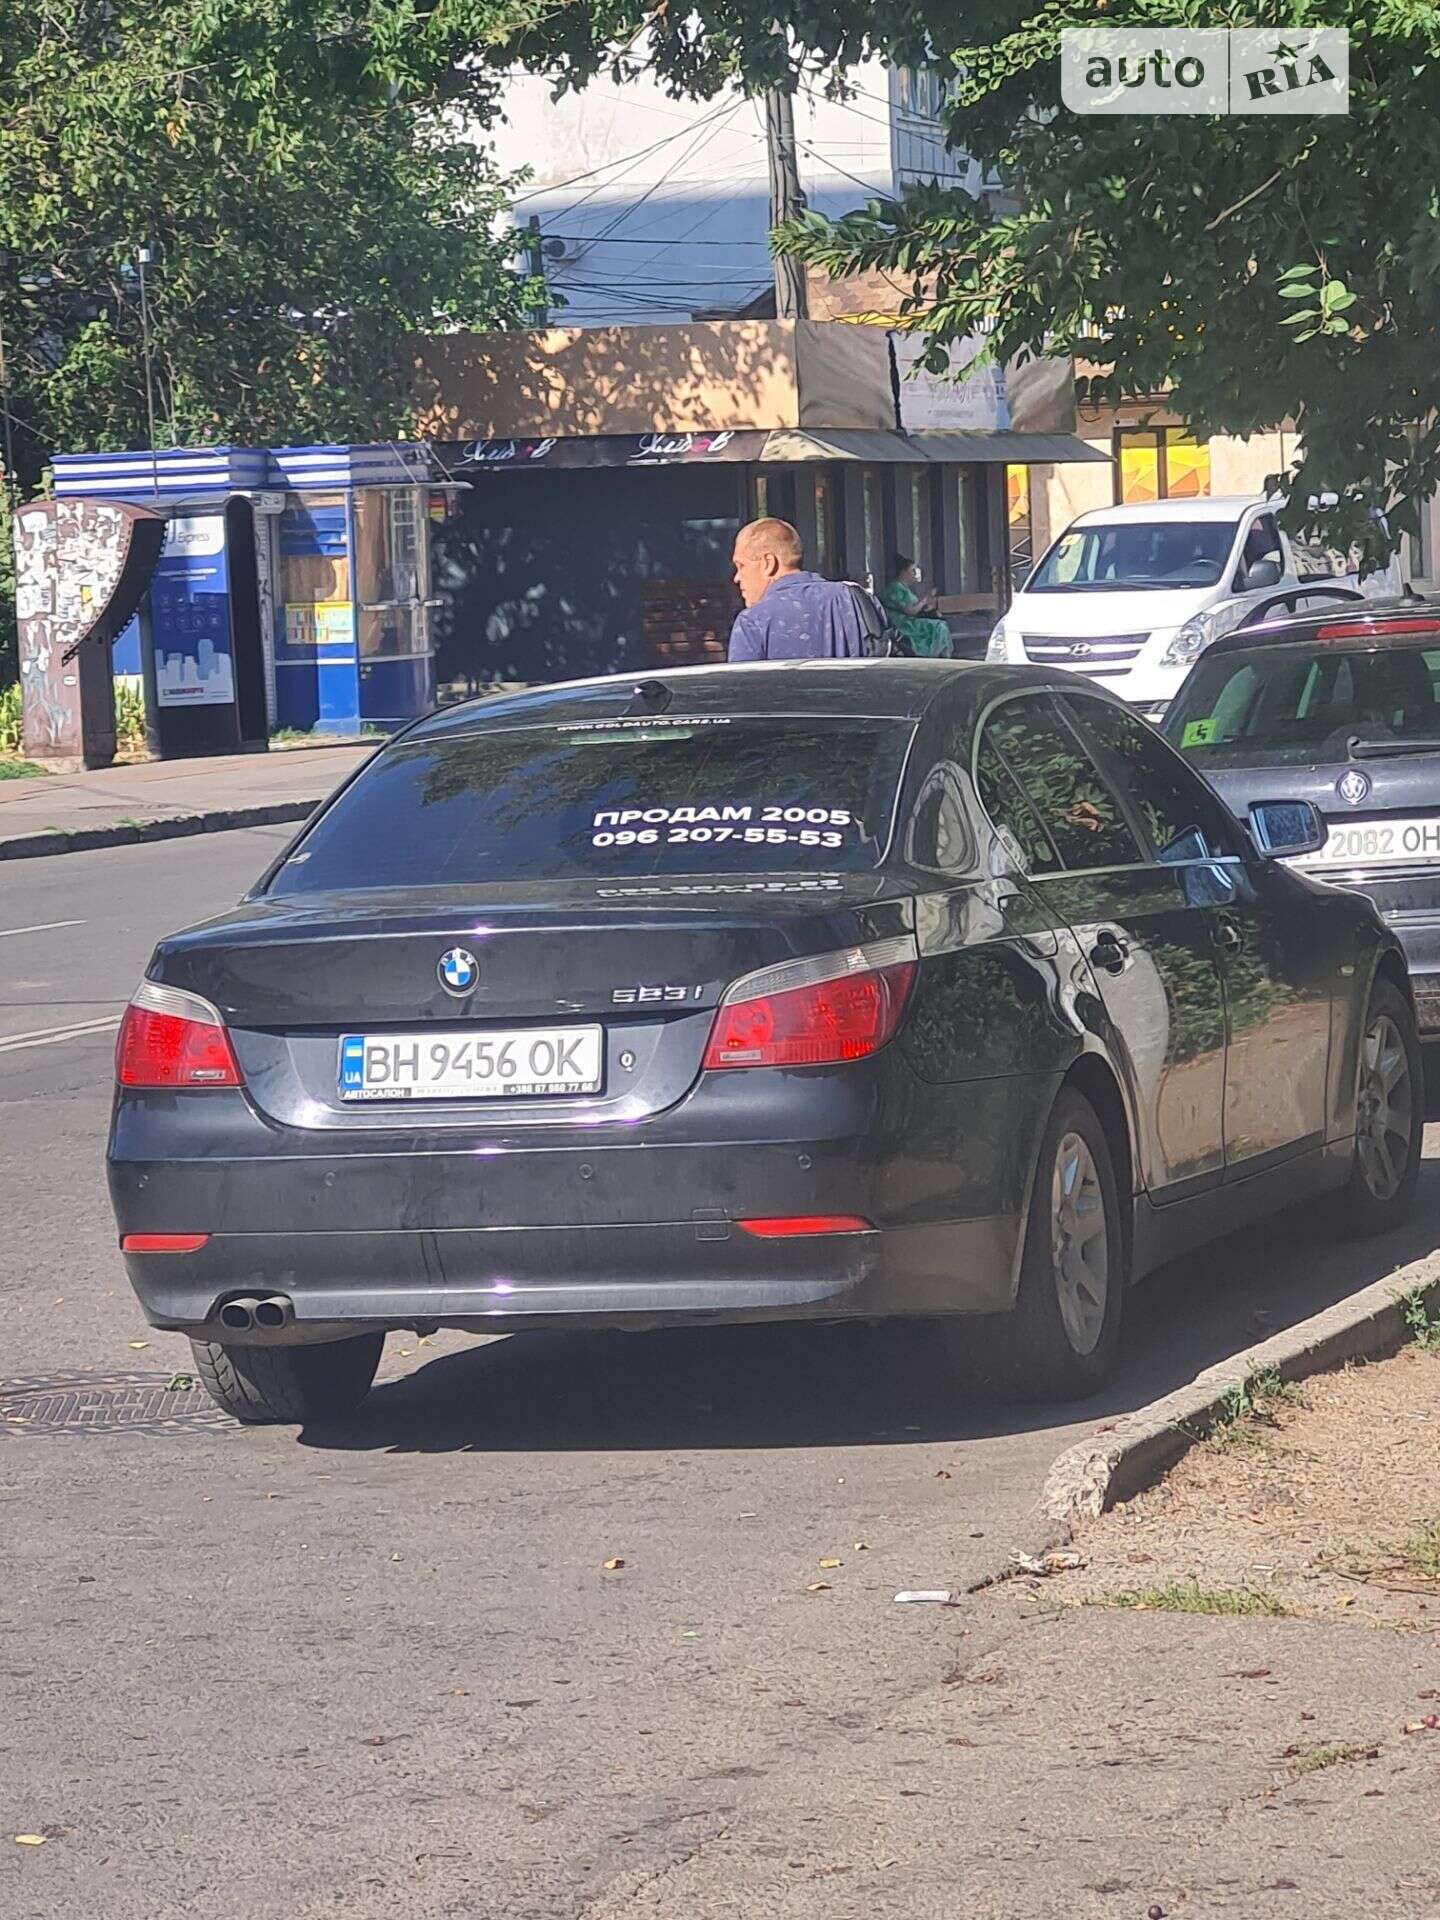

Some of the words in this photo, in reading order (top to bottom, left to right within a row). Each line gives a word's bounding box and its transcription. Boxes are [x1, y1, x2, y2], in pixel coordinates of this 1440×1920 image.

[593, 807, 751, 827] ПРОДАМ
[761, 807, 850, 826] 2005
[592, 829, 658, 847] 096
[668, 828, 843, 848] 207-55-53
[1331, 828, 1395, 858] 2082
[366, 1043, 419, 1082] BH
[430, 1040, 517, 1080] 9456
[528, 1037, 585, 1077] OK
[345, 1071, 361, 1084] UA
